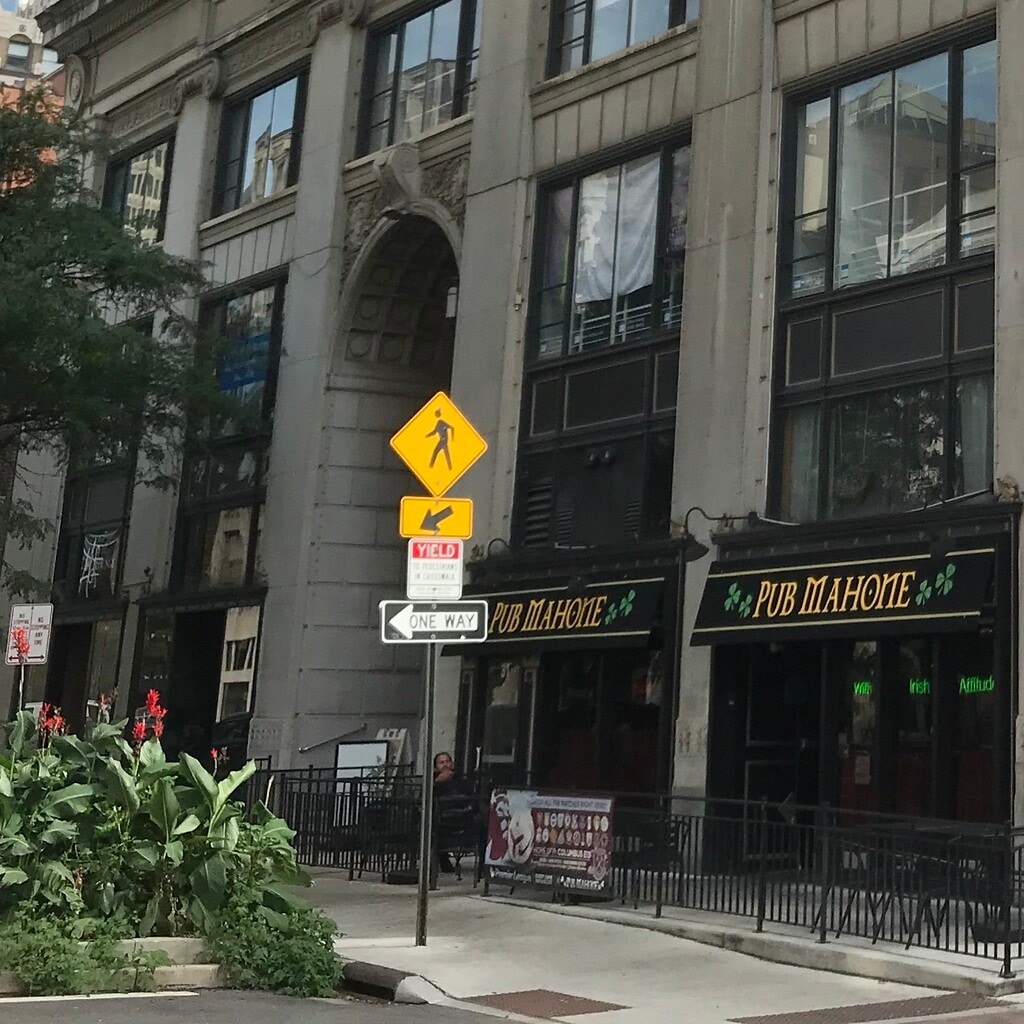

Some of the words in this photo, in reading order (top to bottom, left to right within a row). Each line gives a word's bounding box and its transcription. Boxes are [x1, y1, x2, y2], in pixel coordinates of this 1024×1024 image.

[417, 543, 456, 558] YIELD
[752, 580, 798, 618] PUB
[797, 570, 917, 616] MAHONE
[409, 614, 437, 629] ONE
[444, 613, 475, 628] WAY
[488, 602, 523, 634] PUB
[521, 595, 608, 632] MAHONE
[909, 677, 931, 695] Irish
